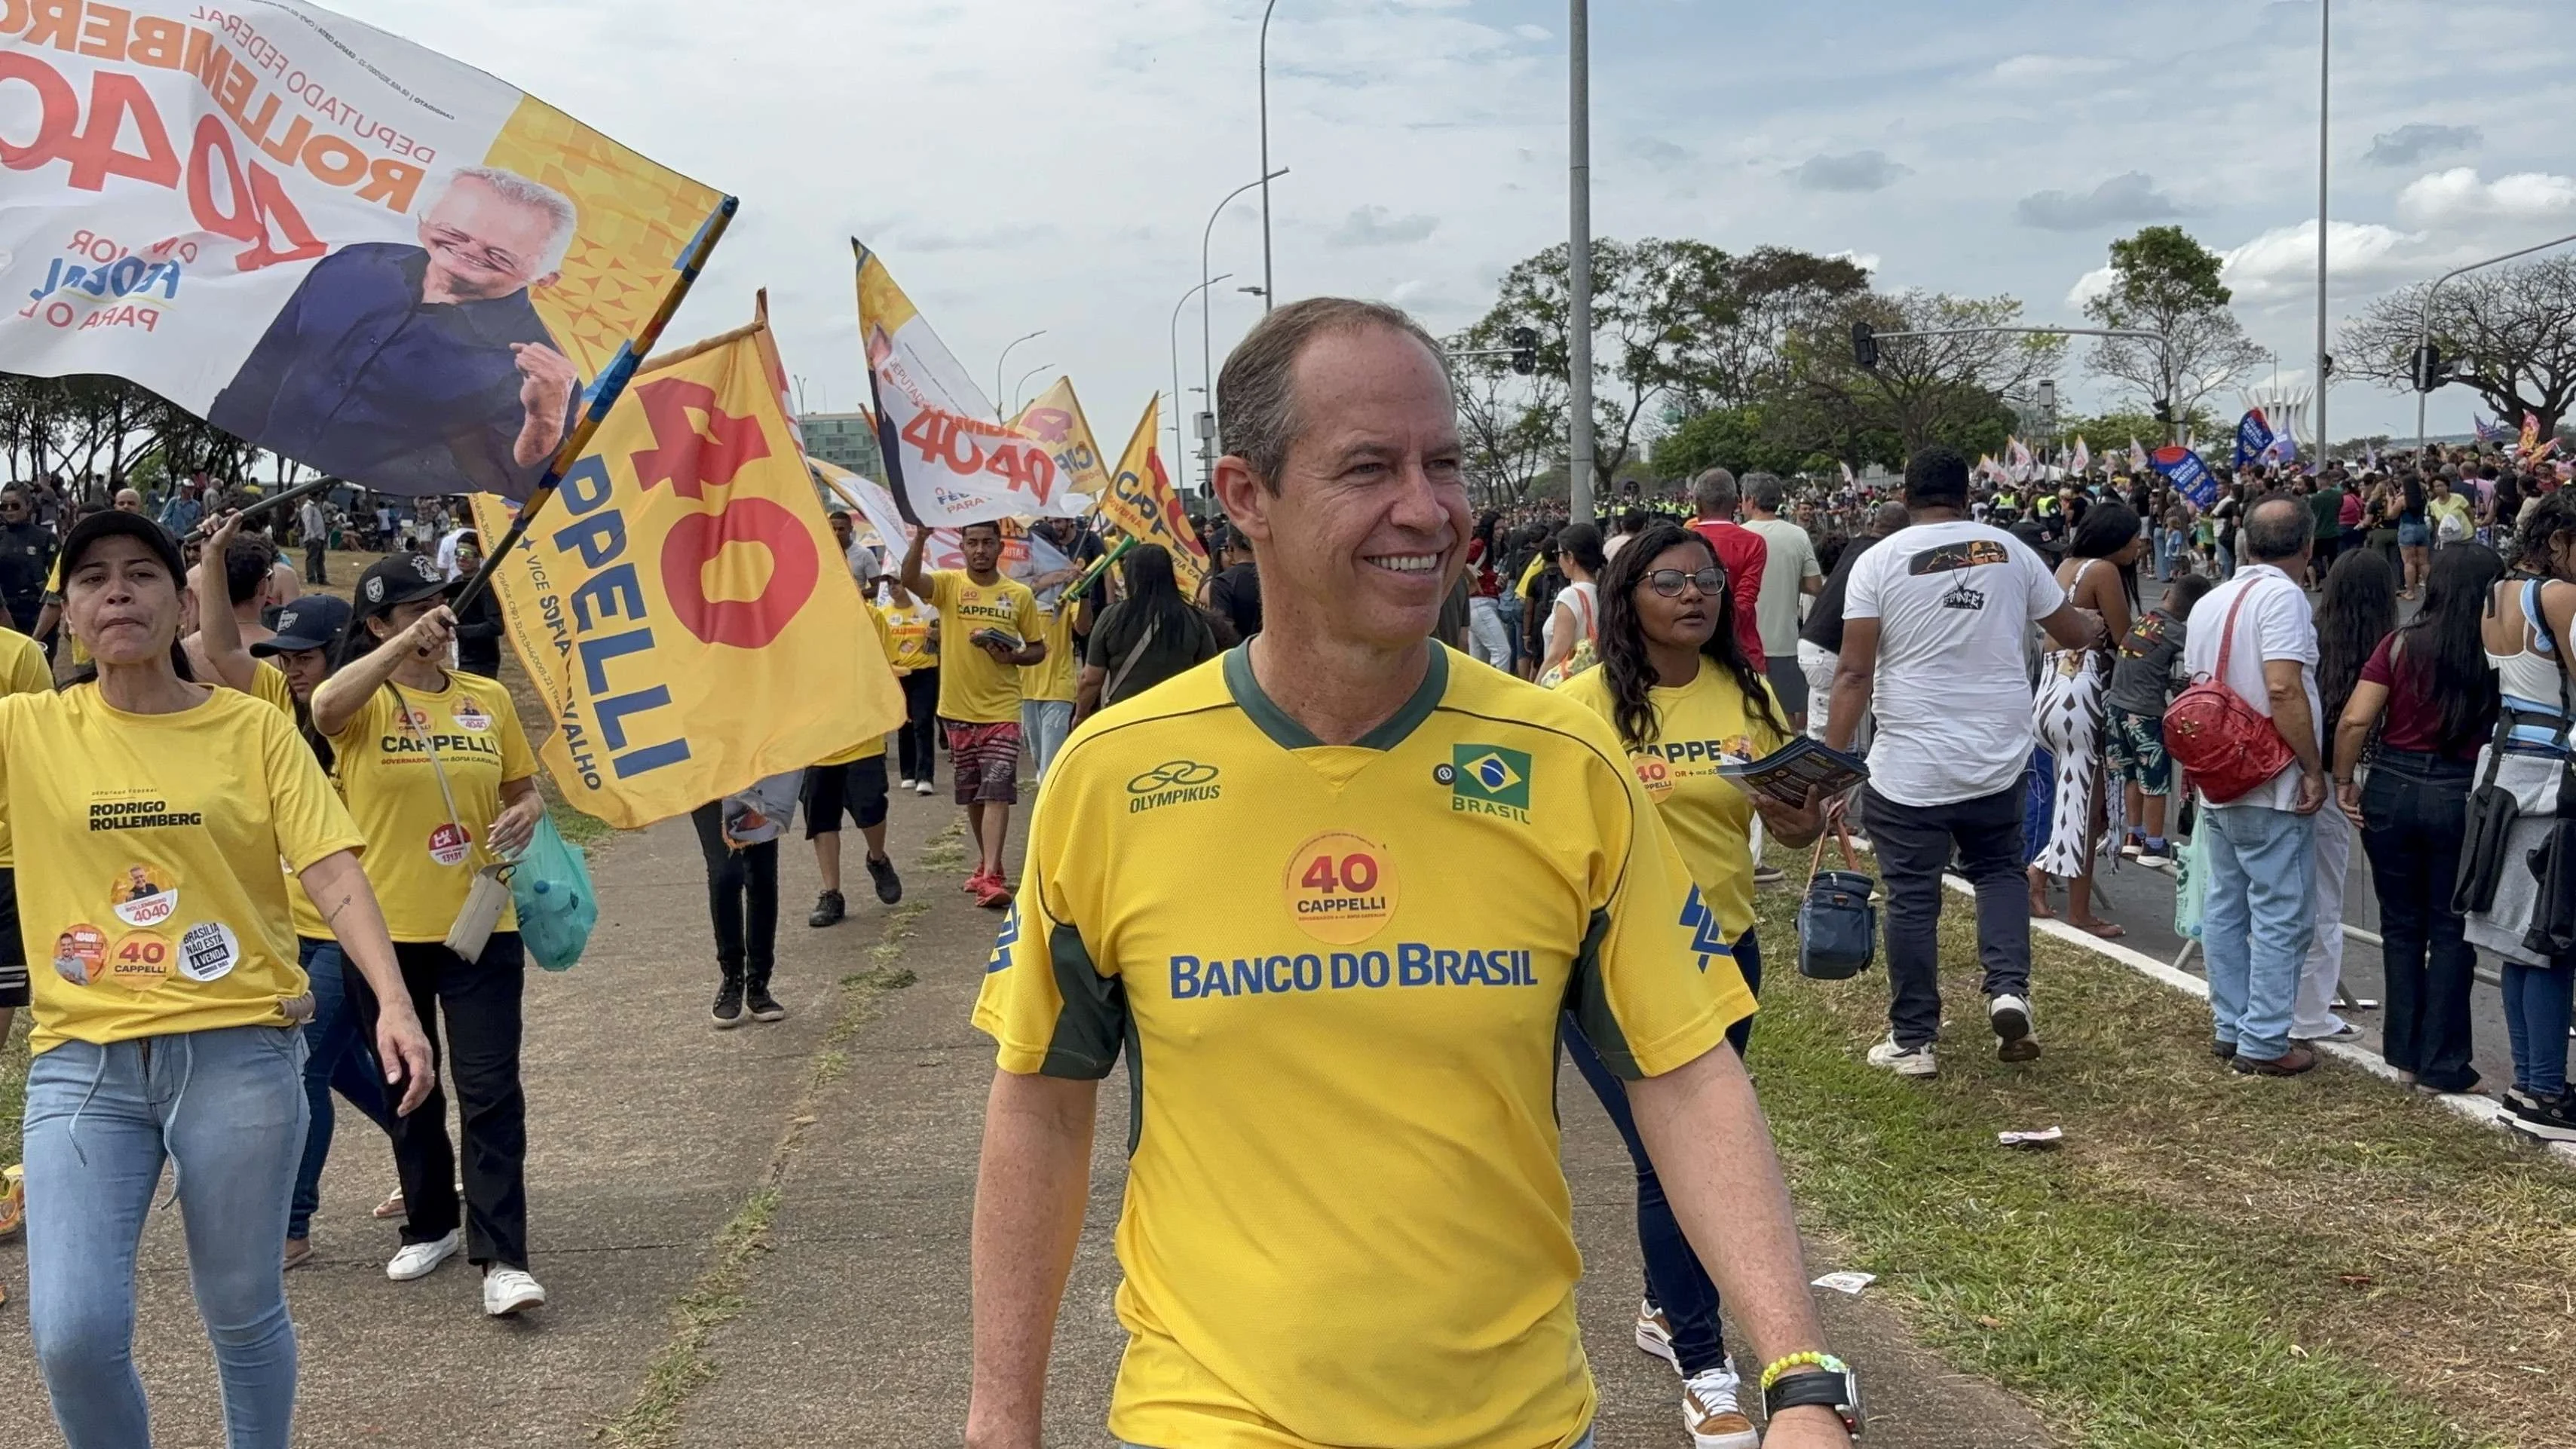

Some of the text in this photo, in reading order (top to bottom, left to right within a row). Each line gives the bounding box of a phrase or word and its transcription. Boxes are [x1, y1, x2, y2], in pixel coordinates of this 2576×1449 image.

[902, 409, 1055, 507] 4040
[630, 377, 819, 649] 40
[947, 497, 985, 513] PARA
[526, 555, 550, 591] VICE
[540, 595, 572, 657] SOFIA
[90, 801, 166, 816] RODRIGO
[1129, 785, 1221, 813] OLYMPIKUS
[1453, 796, 1530, 826] BRASIL
[90, 813, 201, 831] ROLLEMBERG
[1301, 853, 1378, 894] 40
[133, 904, 170, 923] 4040
[1297, 896, 1386, 913] CAPPELLI
[119, 942, 165, 963] 40
[199, 947, 226, 964] VENDA
[114, 965, 167, 973] CAPPELLI
[1170, 942, 1539, 1000] BANCO DO BRASIL
